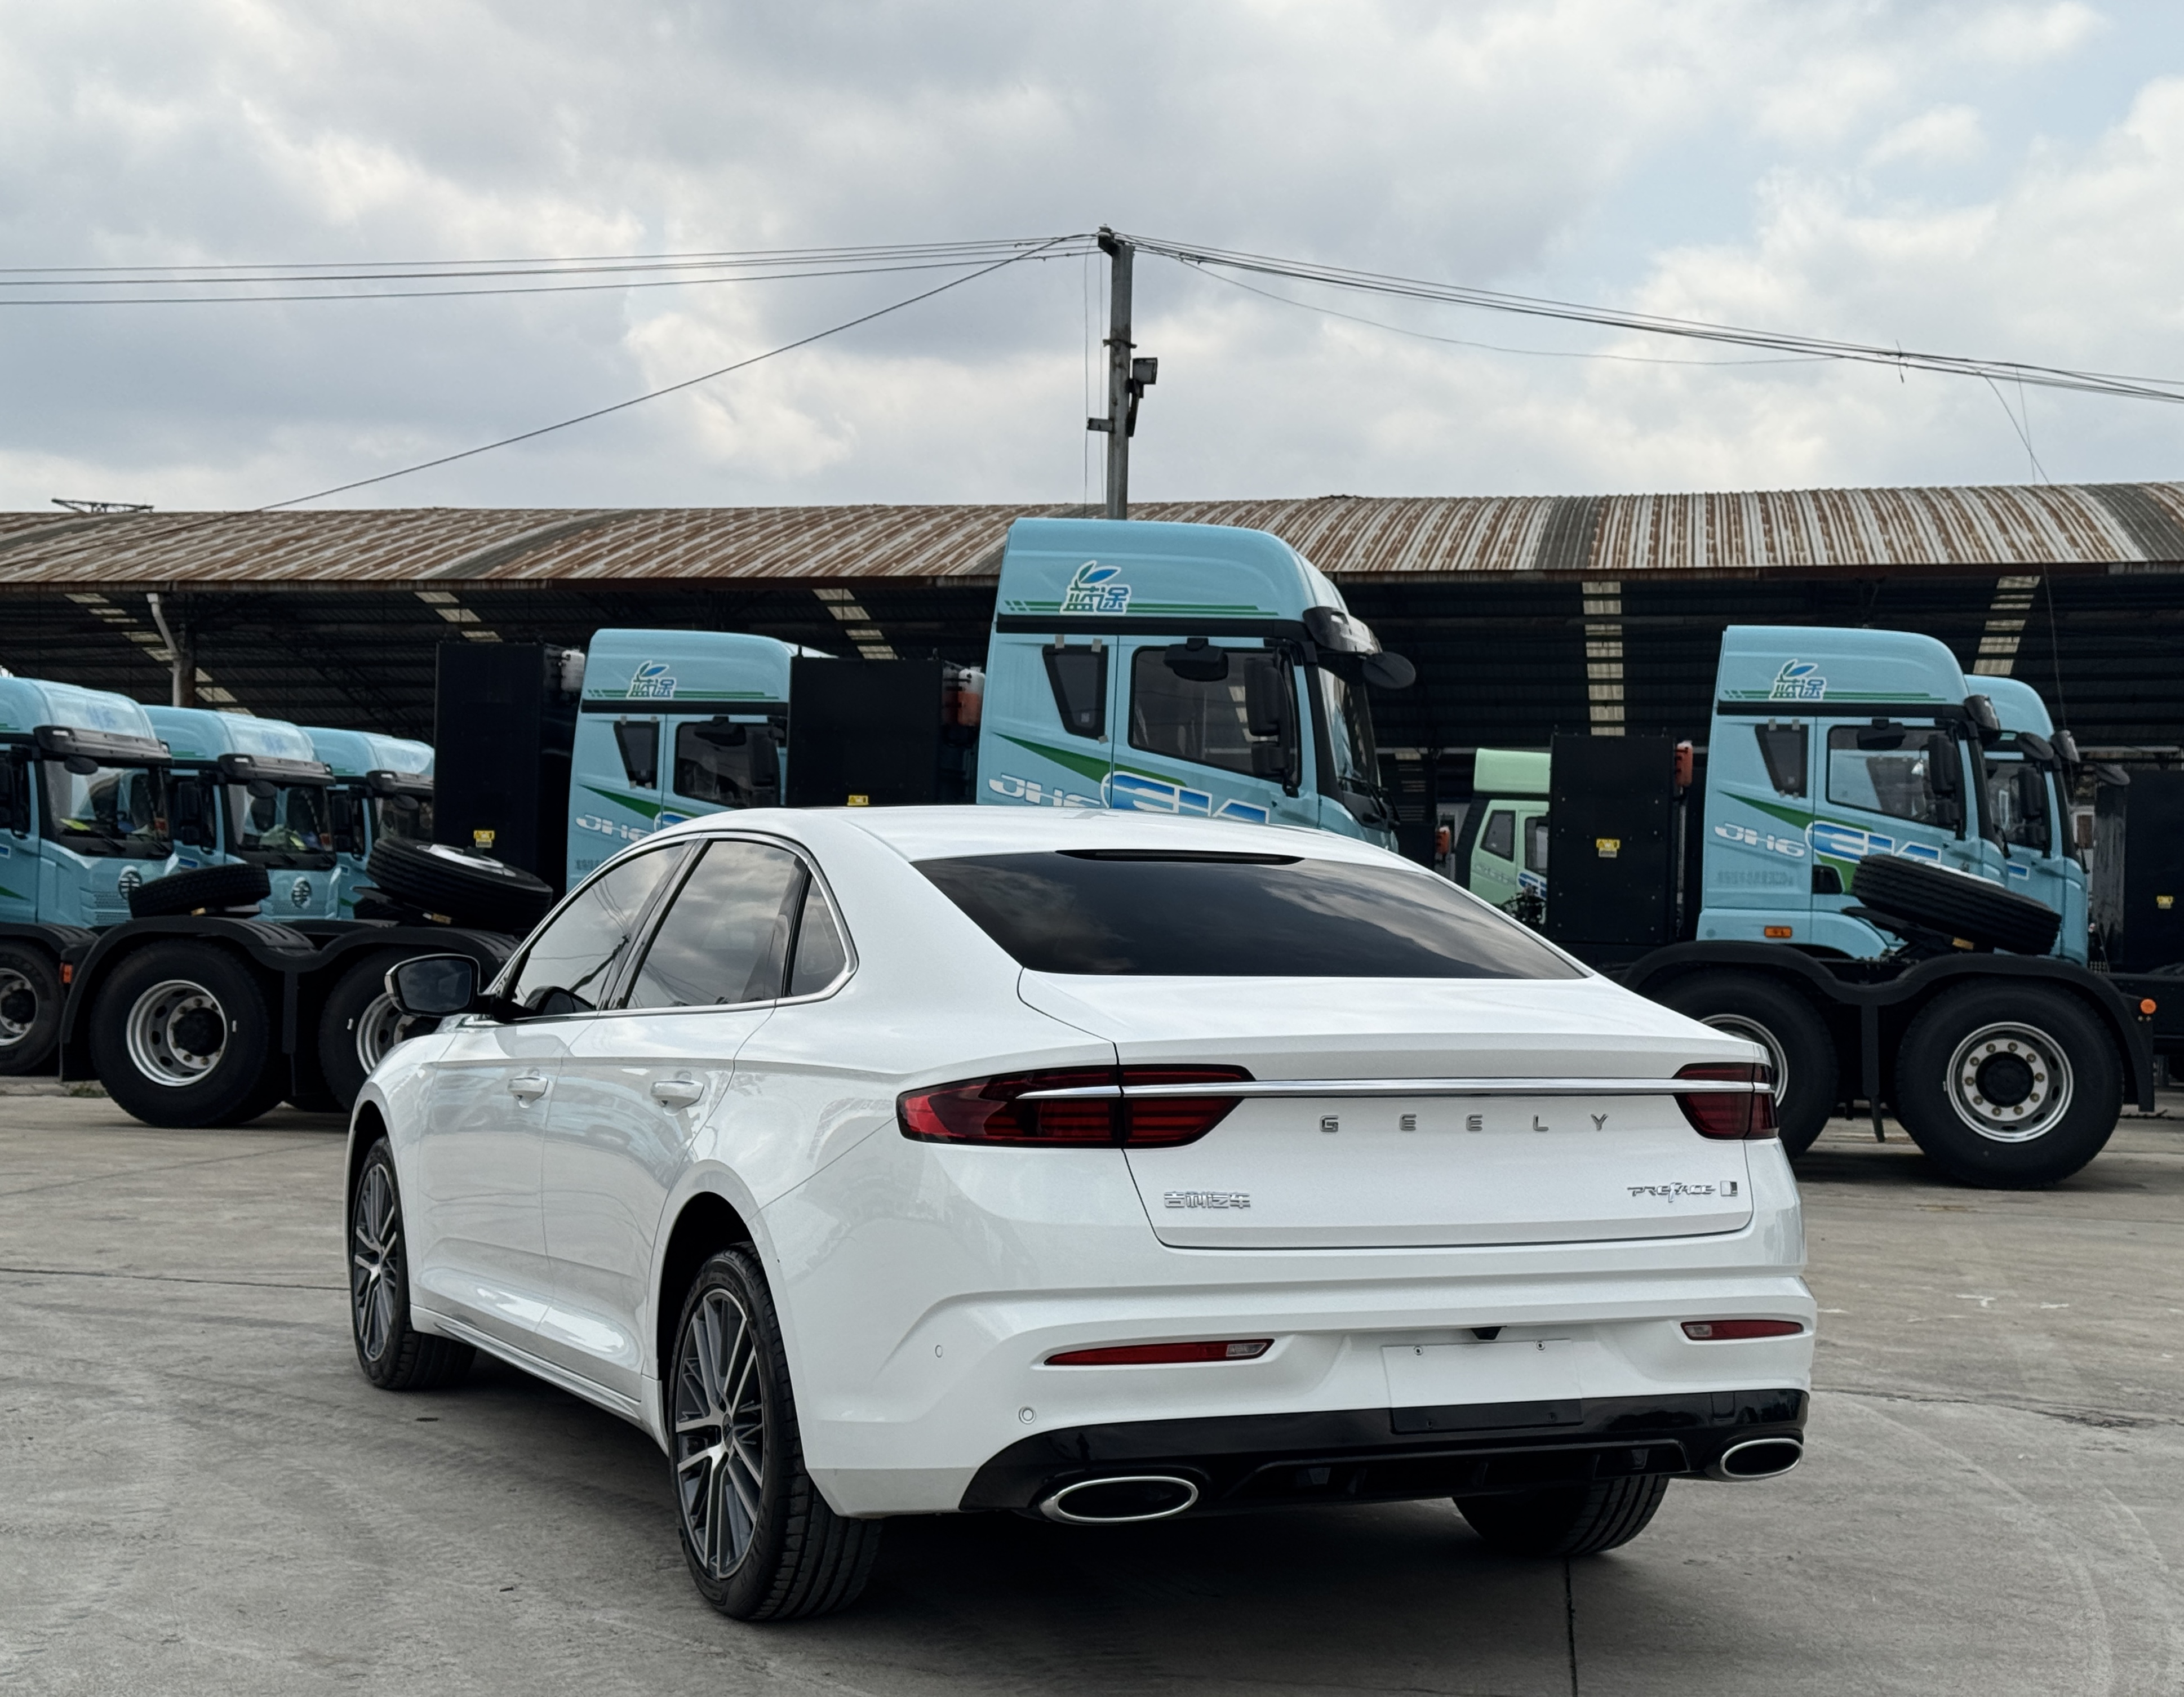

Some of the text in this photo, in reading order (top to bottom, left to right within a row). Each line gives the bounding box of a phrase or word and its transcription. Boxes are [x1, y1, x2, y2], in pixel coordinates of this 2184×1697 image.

[1061, 577, 1130, 613] 蓝途
[1714, 822, 1805, 858] JH6
[1319, 1113, 1608, 1132] GEELY
